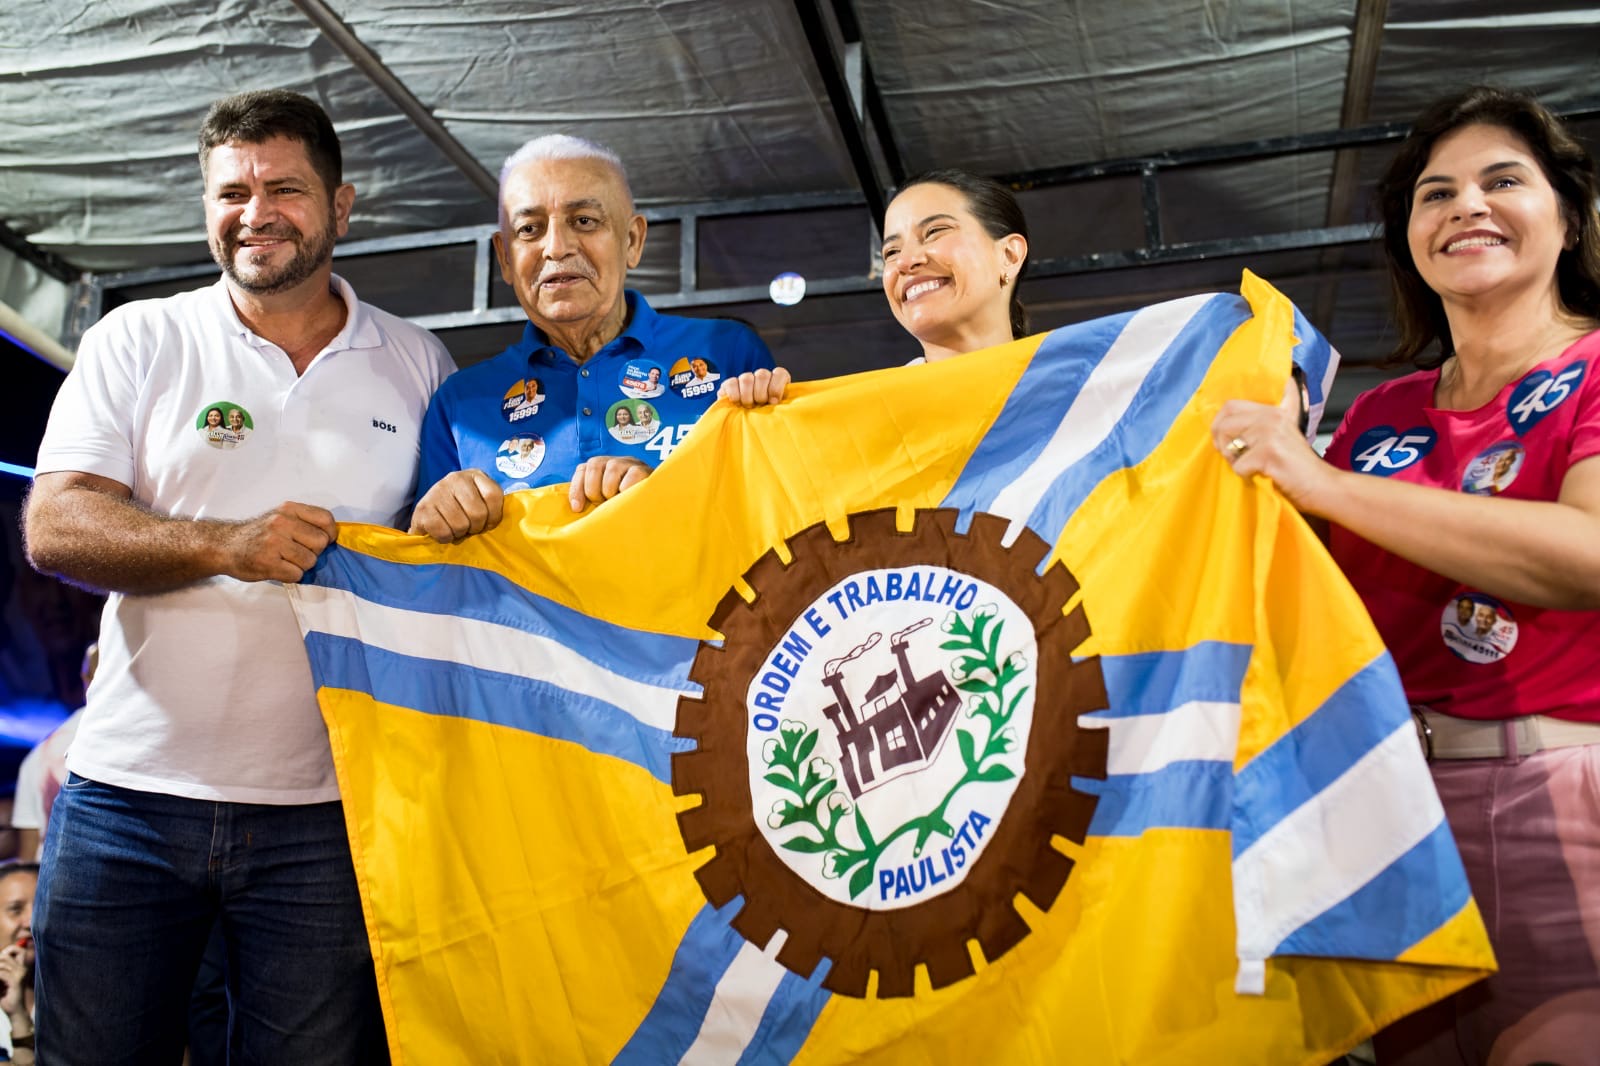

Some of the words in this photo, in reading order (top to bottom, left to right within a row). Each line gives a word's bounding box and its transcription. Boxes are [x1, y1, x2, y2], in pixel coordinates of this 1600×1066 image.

[681, 382, 715, 398] 15999
[1511, 368, 1582, 423] 45
[372, 419, 397, 433] BOSS
[509, 404, 539, 422] 15999
[1354, 435, 1431, 472] 45
[752, 631, 813, 732] ORDEM
[803, 607, 832, 638] E
[827, 572, 978, 620] TRABALHO
[879, 809, 991, 901] PAULISTA
